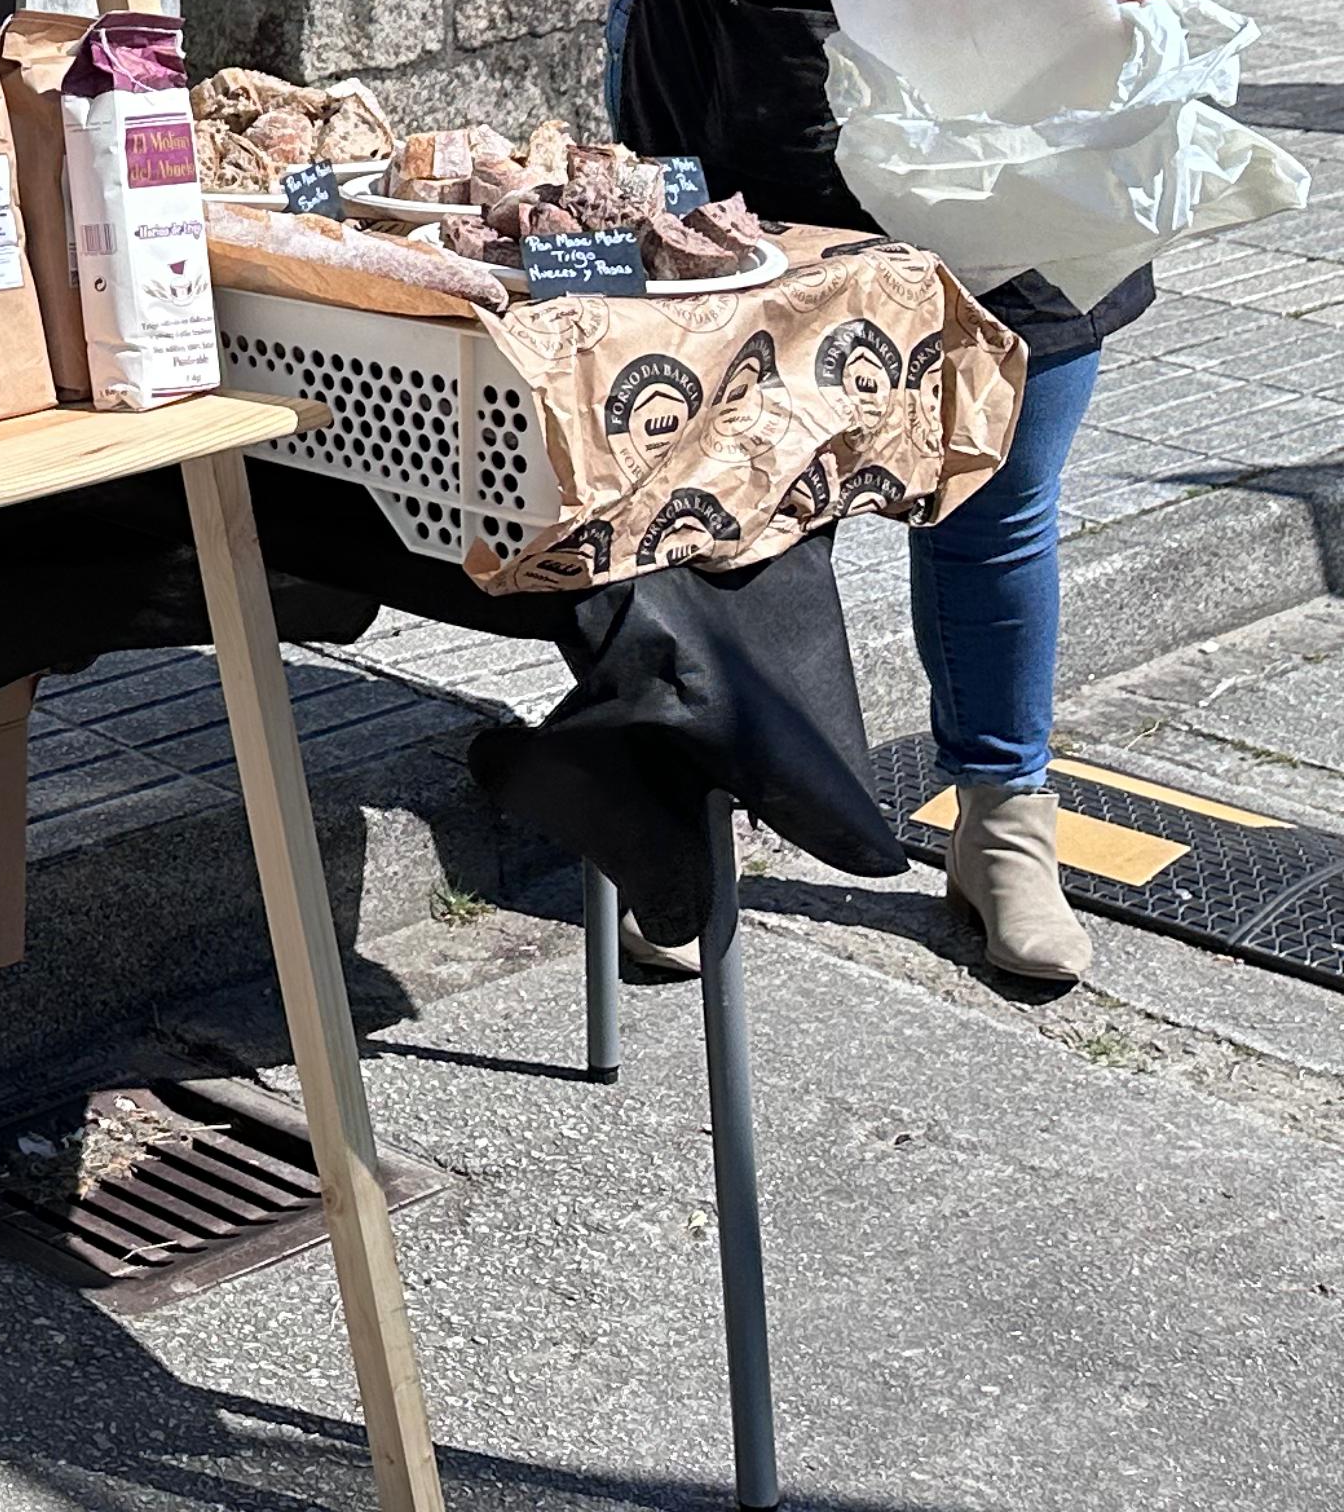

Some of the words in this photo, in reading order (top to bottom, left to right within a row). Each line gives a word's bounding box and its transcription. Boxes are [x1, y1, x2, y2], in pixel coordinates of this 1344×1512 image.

[525, 235, 553, 252] Pan
[555, 233, 592, 248] Masa
[594, 229, 637, 247] Madre
[529, 263, 577, 282] Nueces
[583, 268, 592, 282] y
[823, 331, 855, 379] FORNO
[611, 371, 640, 425] FORNO
[641, 363, 660, 378] DA
[663, 363, 699, 409] BARCIA
